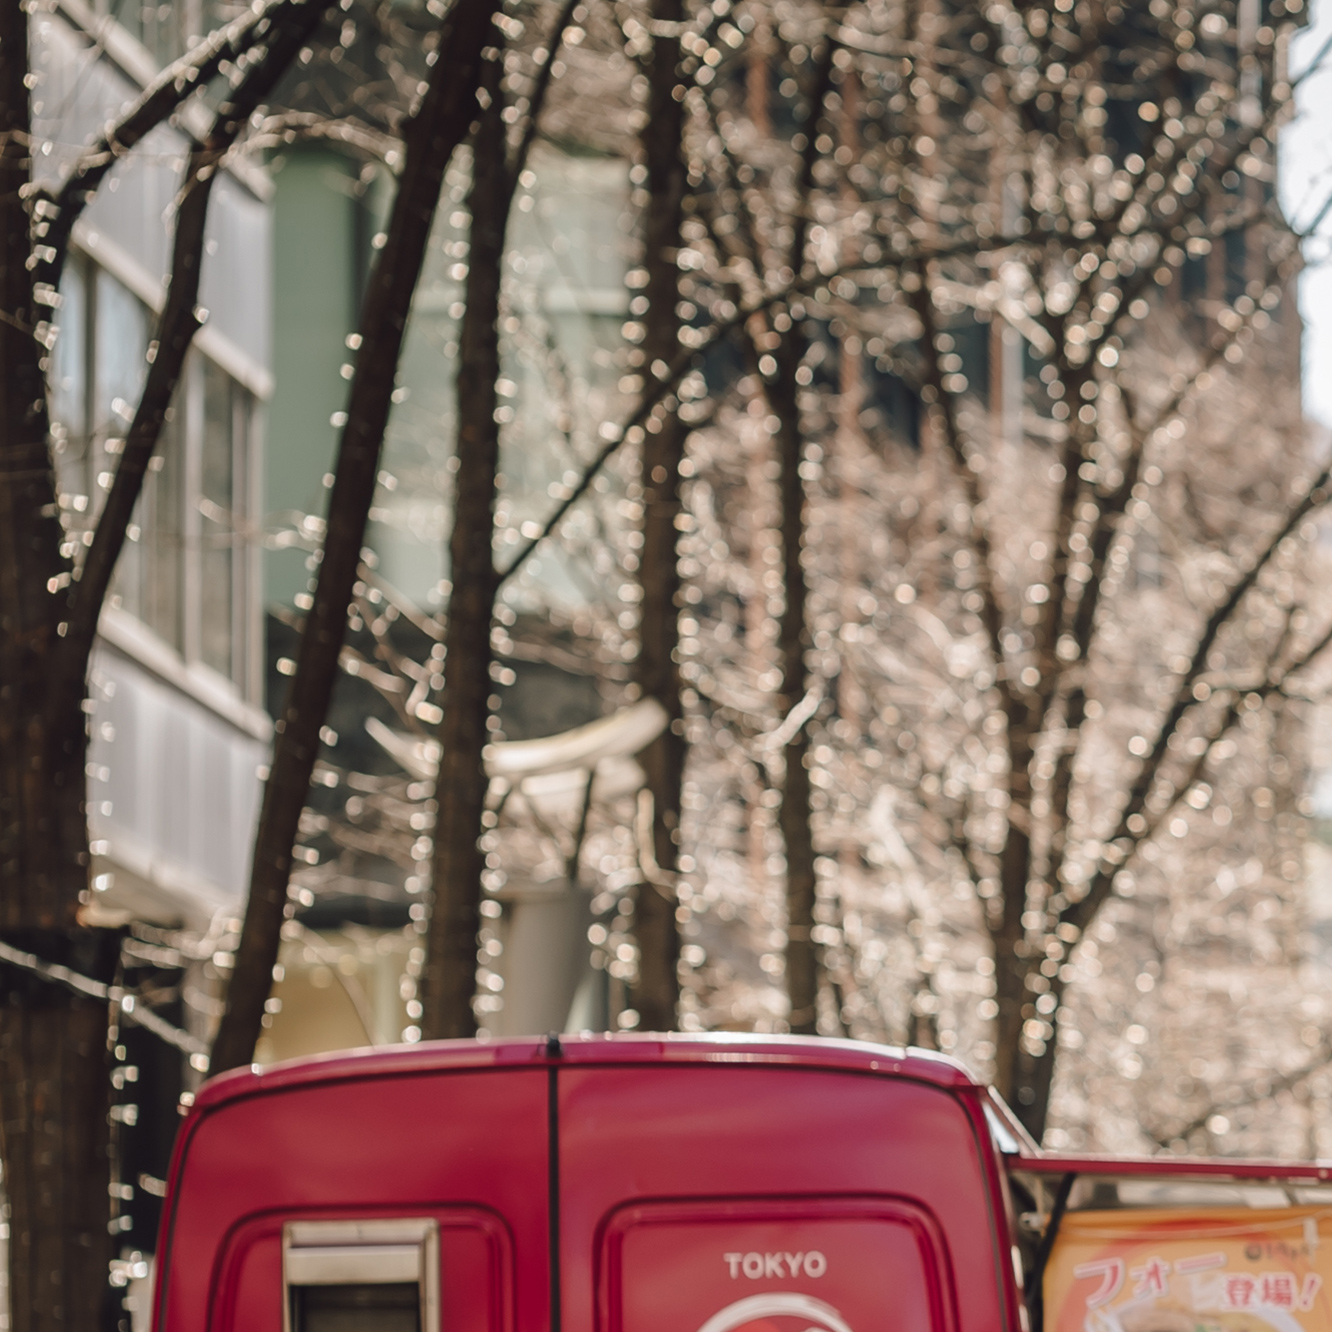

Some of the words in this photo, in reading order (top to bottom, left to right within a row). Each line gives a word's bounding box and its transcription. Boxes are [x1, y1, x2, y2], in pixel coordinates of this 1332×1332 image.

[723, 1250, 828, 1280] TOKYO
[1073, 1252, 1227, 1310] フォー
